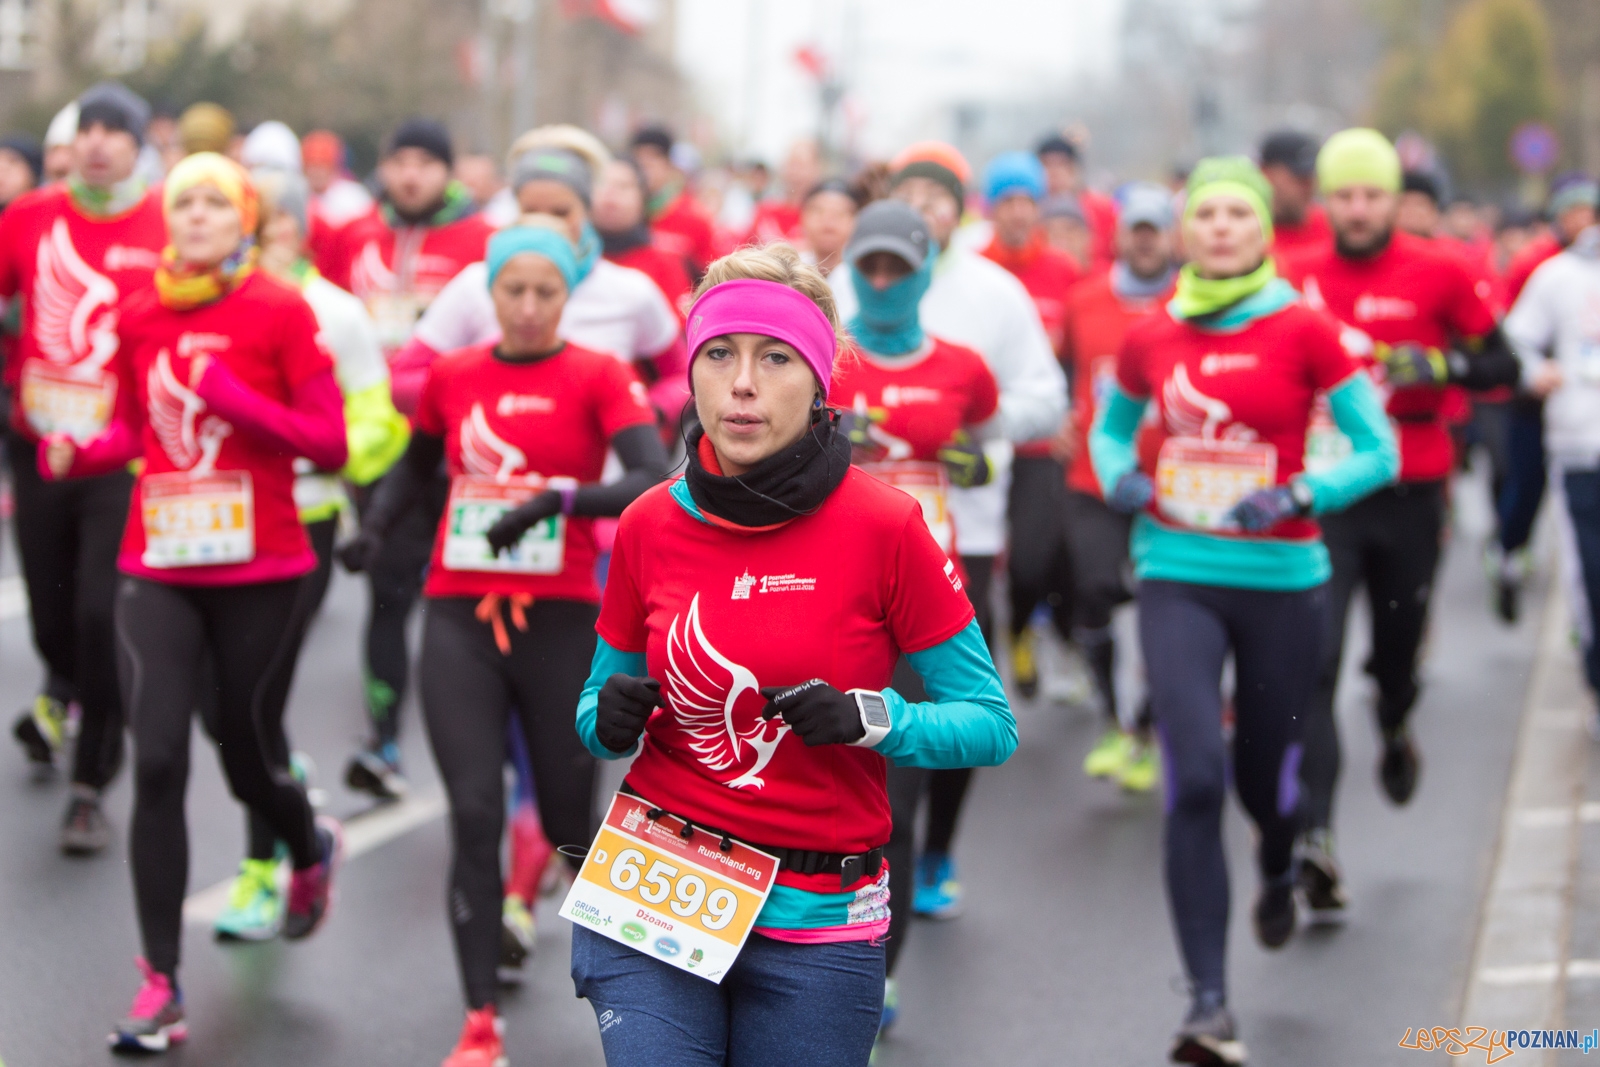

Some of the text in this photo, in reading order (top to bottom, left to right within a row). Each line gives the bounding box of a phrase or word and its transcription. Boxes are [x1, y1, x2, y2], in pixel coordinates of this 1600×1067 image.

[759, 575, 768, 593] 1
[644, 820, 654, 834] 1
[697, 845, 762, 880] RunPoland.org
[593, 848, 738, 931] D 6599
[570, 907, 602, 926] LUXMED
[574, 899, 600, 916] GRUPA
[636, 908, 674, 932] Dżoana
